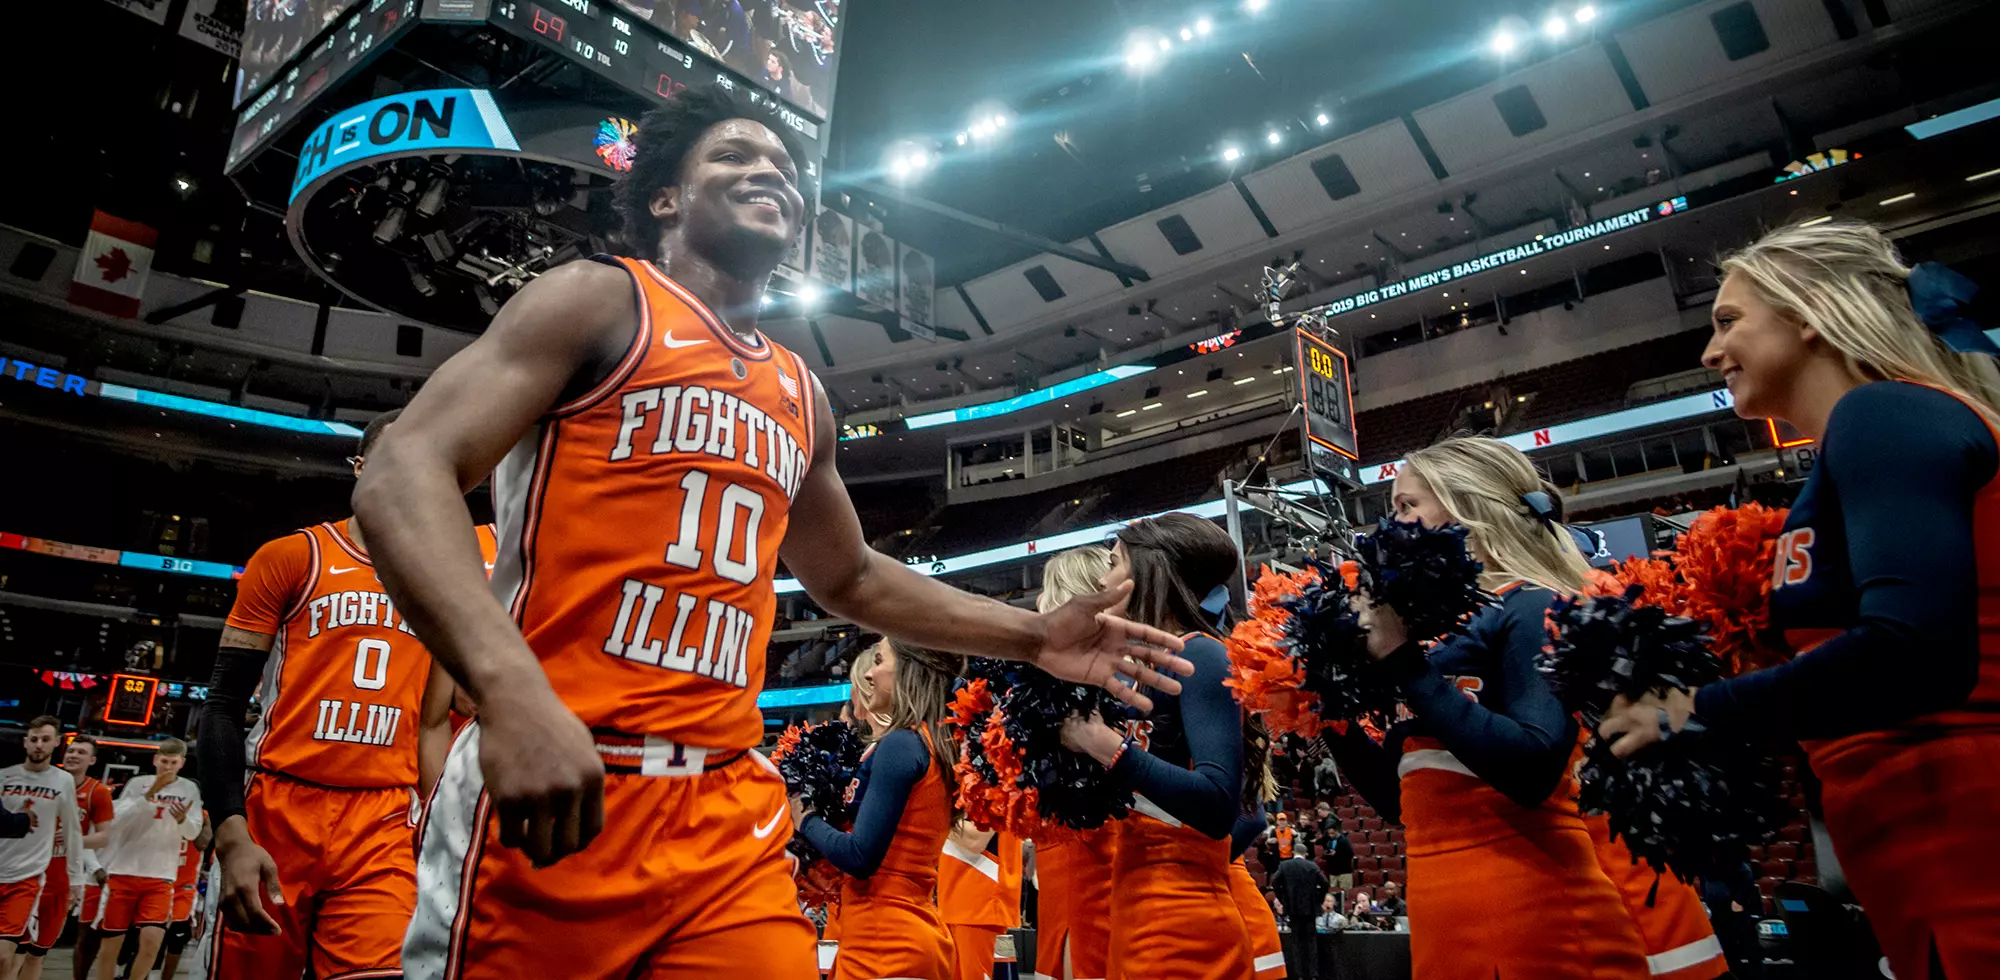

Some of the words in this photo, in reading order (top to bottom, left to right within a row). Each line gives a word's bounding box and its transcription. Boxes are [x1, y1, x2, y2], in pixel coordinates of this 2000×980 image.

[533, 10, 564, 41] 69
[612, 16, 631, 36] FOUL
[682, 55, 693, 69] 3
[341, 125, 357, 145] IS
[369, 97, 456, 146] ON
[1356, 290, 1379, 307] BIG
[1380, 283, 1407, 298] TEN
[1408, 268, 1452, 294] MEN'S
[1453, 242, 1543, 277] BASKETBALL
[1543, 208, 1650, 250] TOURNAMENT
[1533, 429, 1551, 447] N
[665, 469, 765, 585] 10
[308, 591, 416, 638] FIGHT
[603, 578, 753, 688] ILLINI
[352, 638, 391, 691] 0
[313, 700, 402, 747] ILLINI
[1, 785, 62, 800] FAMILY
